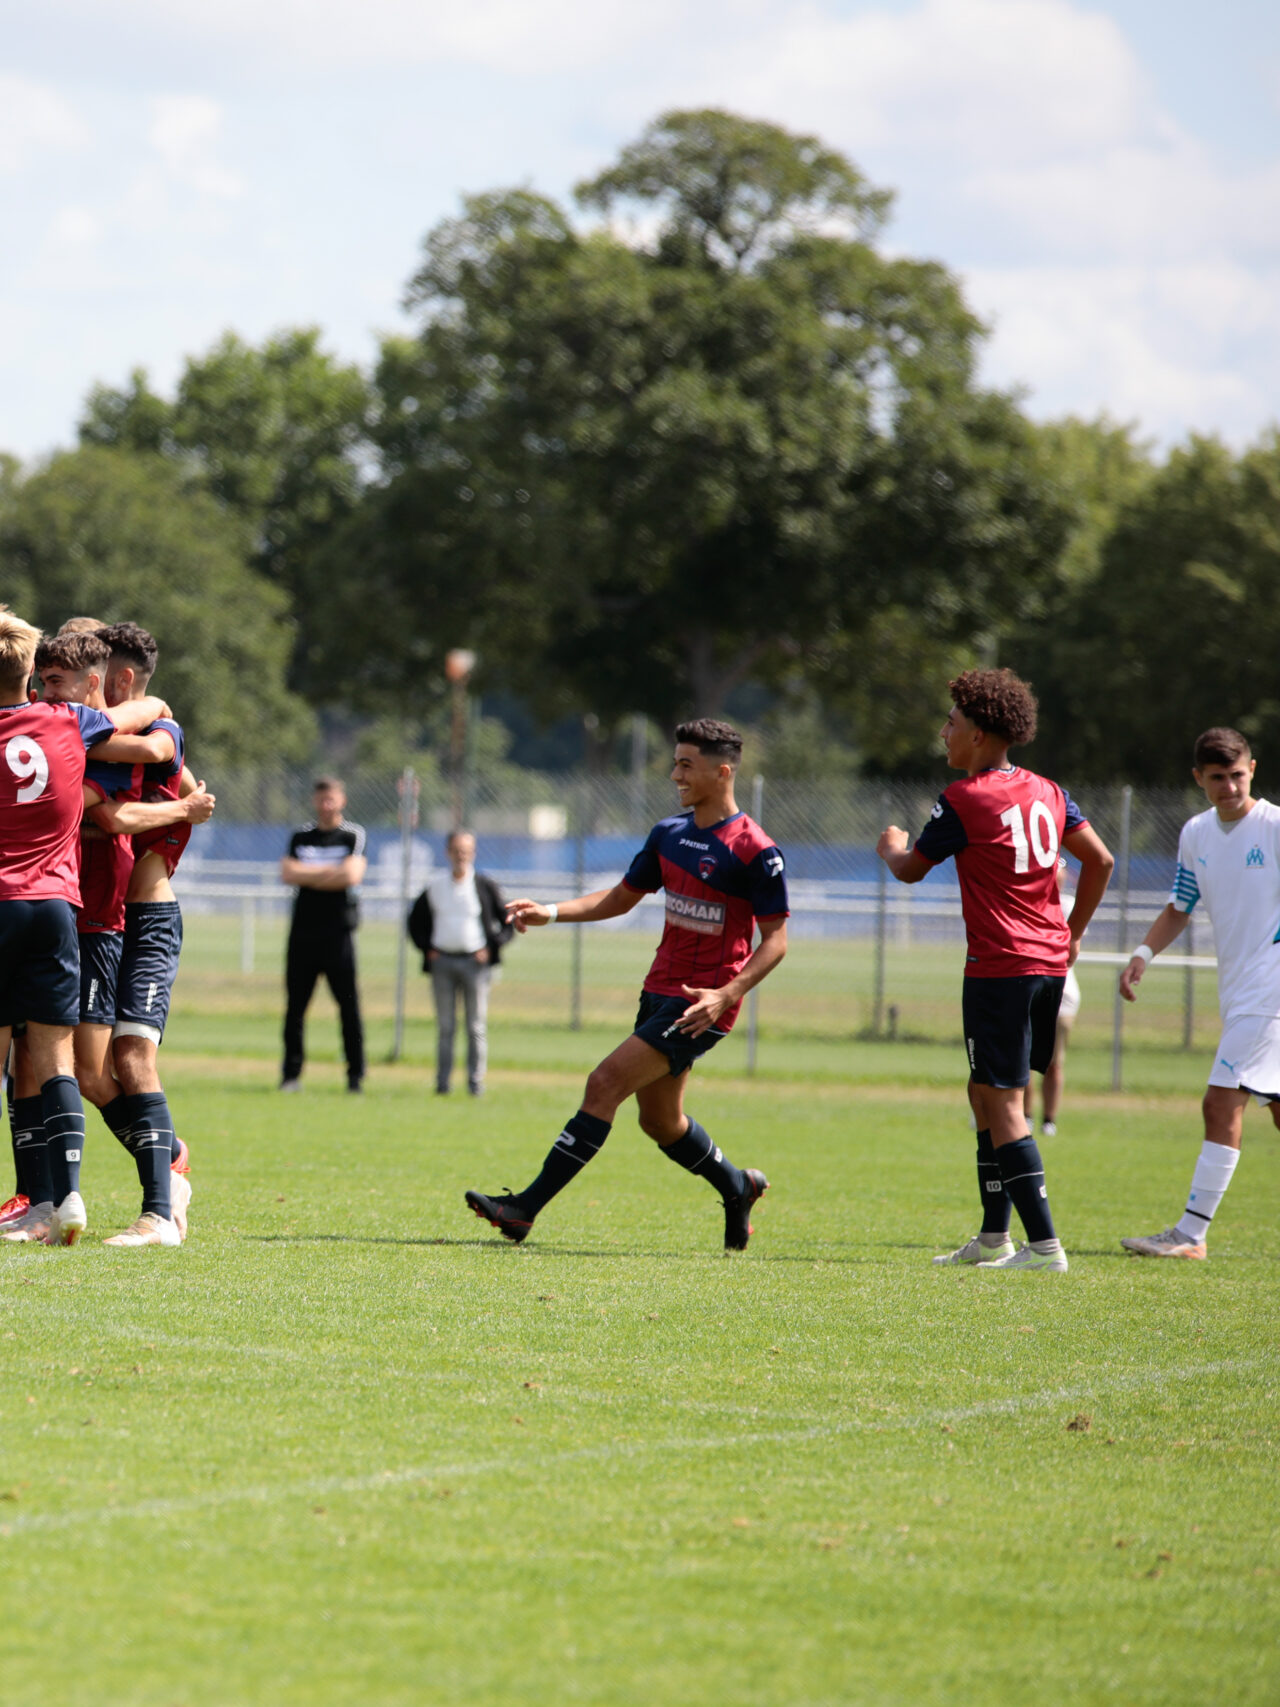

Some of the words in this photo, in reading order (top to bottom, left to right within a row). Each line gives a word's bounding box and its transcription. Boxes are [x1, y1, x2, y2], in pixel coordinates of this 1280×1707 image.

[5, 735, 49, 802] 9
[685, 839, 709, 851] PATRICK
[1000, 800, 1058, 873] 10
[987, 1182, 1000, 1191] 10
